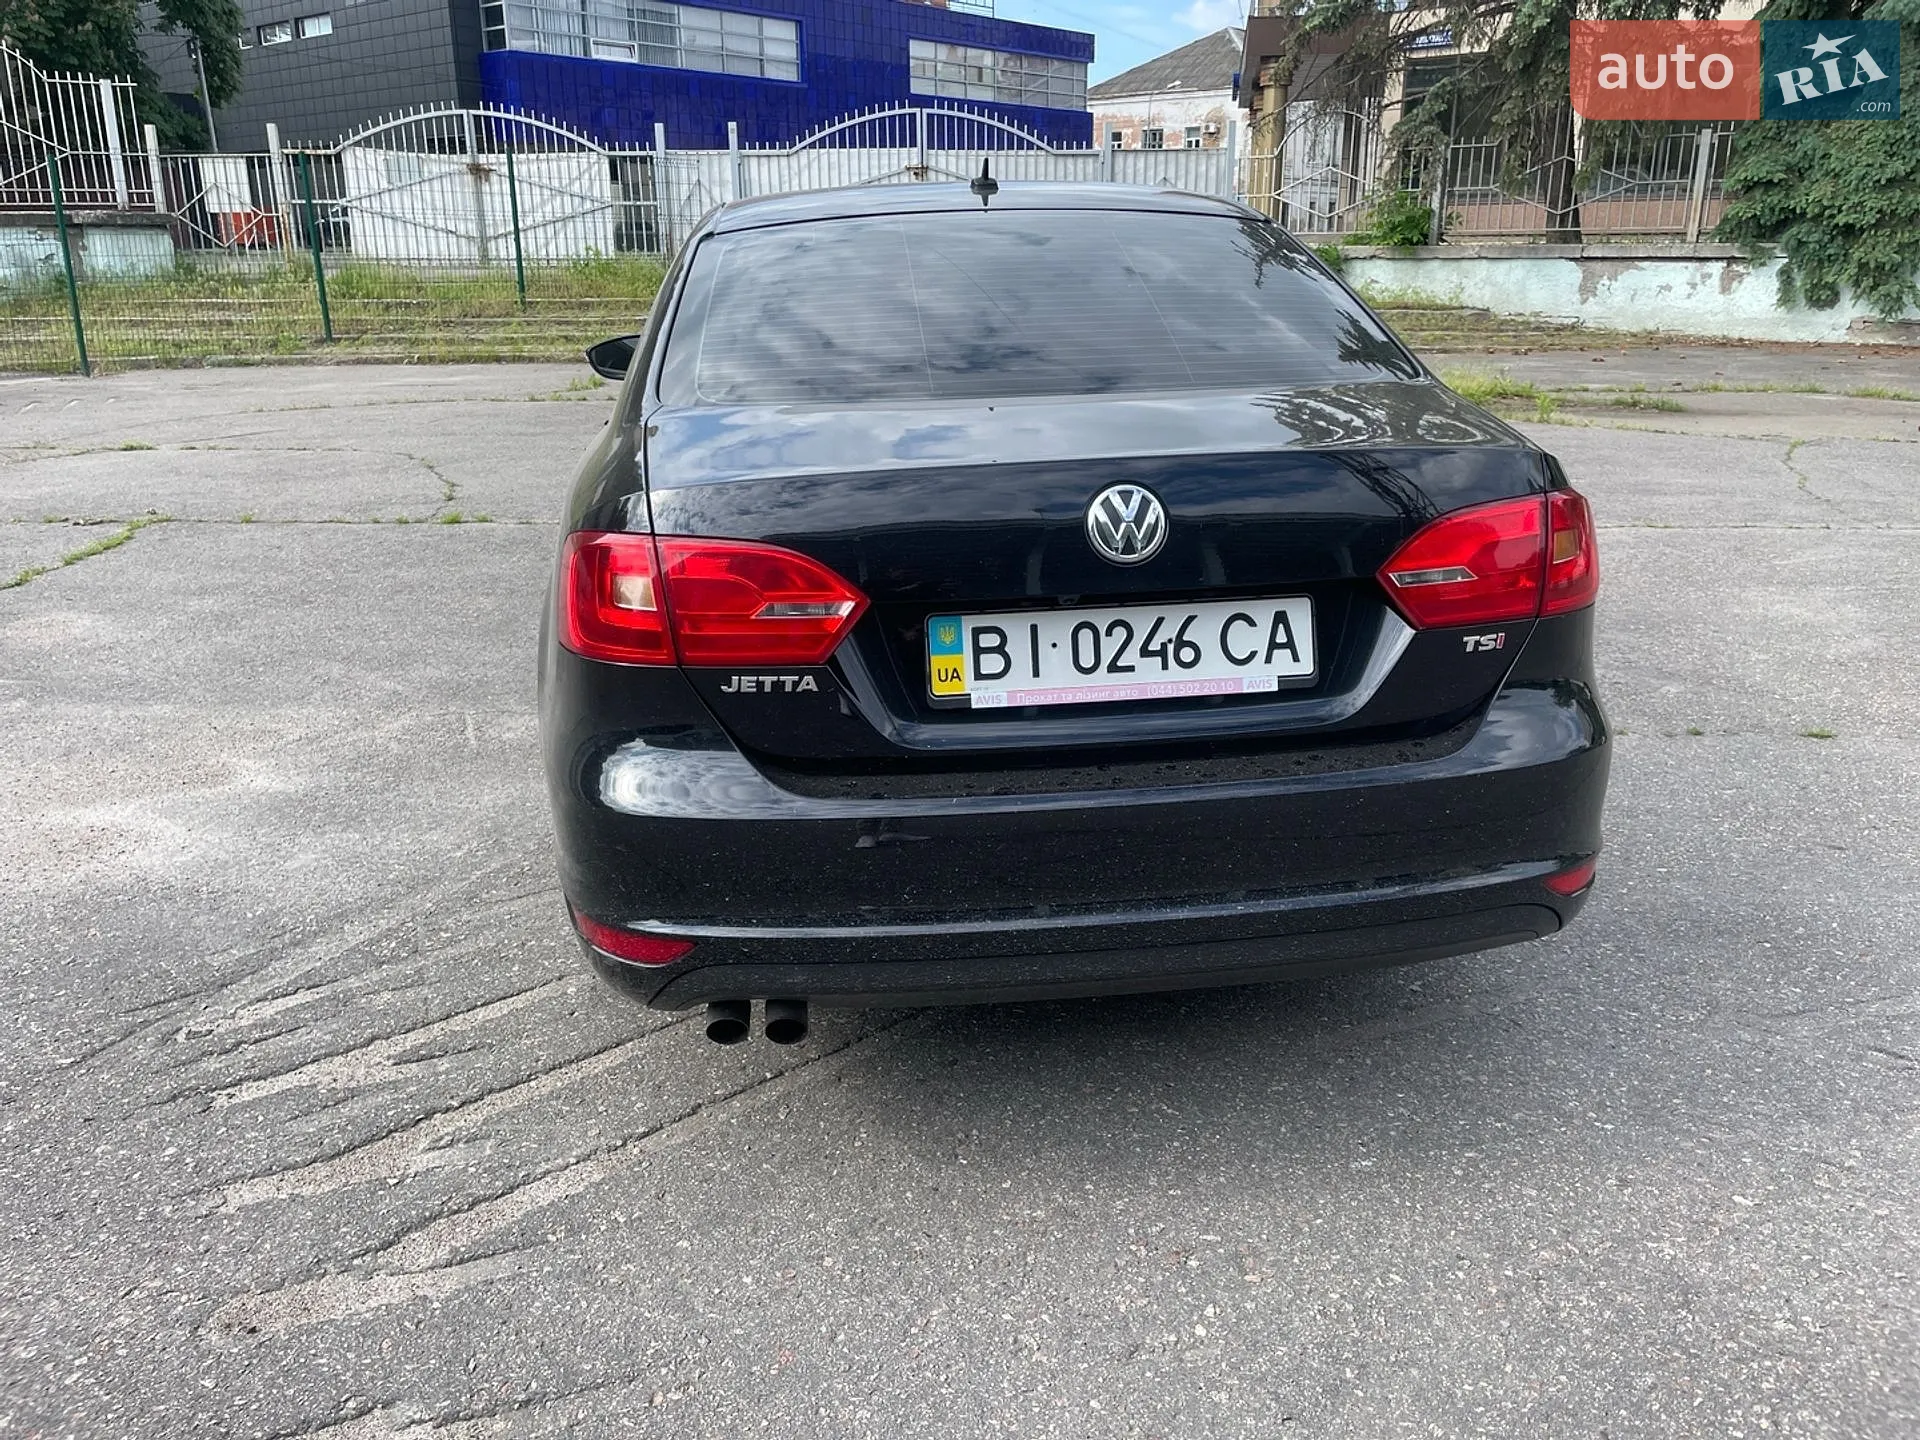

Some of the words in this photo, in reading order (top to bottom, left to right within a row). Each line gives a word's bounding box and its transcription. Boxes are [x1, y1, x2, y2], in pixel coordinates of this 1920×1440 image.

[1070, 614, 1203, 675] 0246
[1219, 609, 1301, 667] CA
[720, 675, 820, 693] JETTA
[937, 667, 962, 682] UA
[975, 694, 1003, 706] AVIS
[1180, 684, 1199, 695] 502
[1201, 682, 1217, 693] 20
[1246, 678, 1273, 690] AVIS
